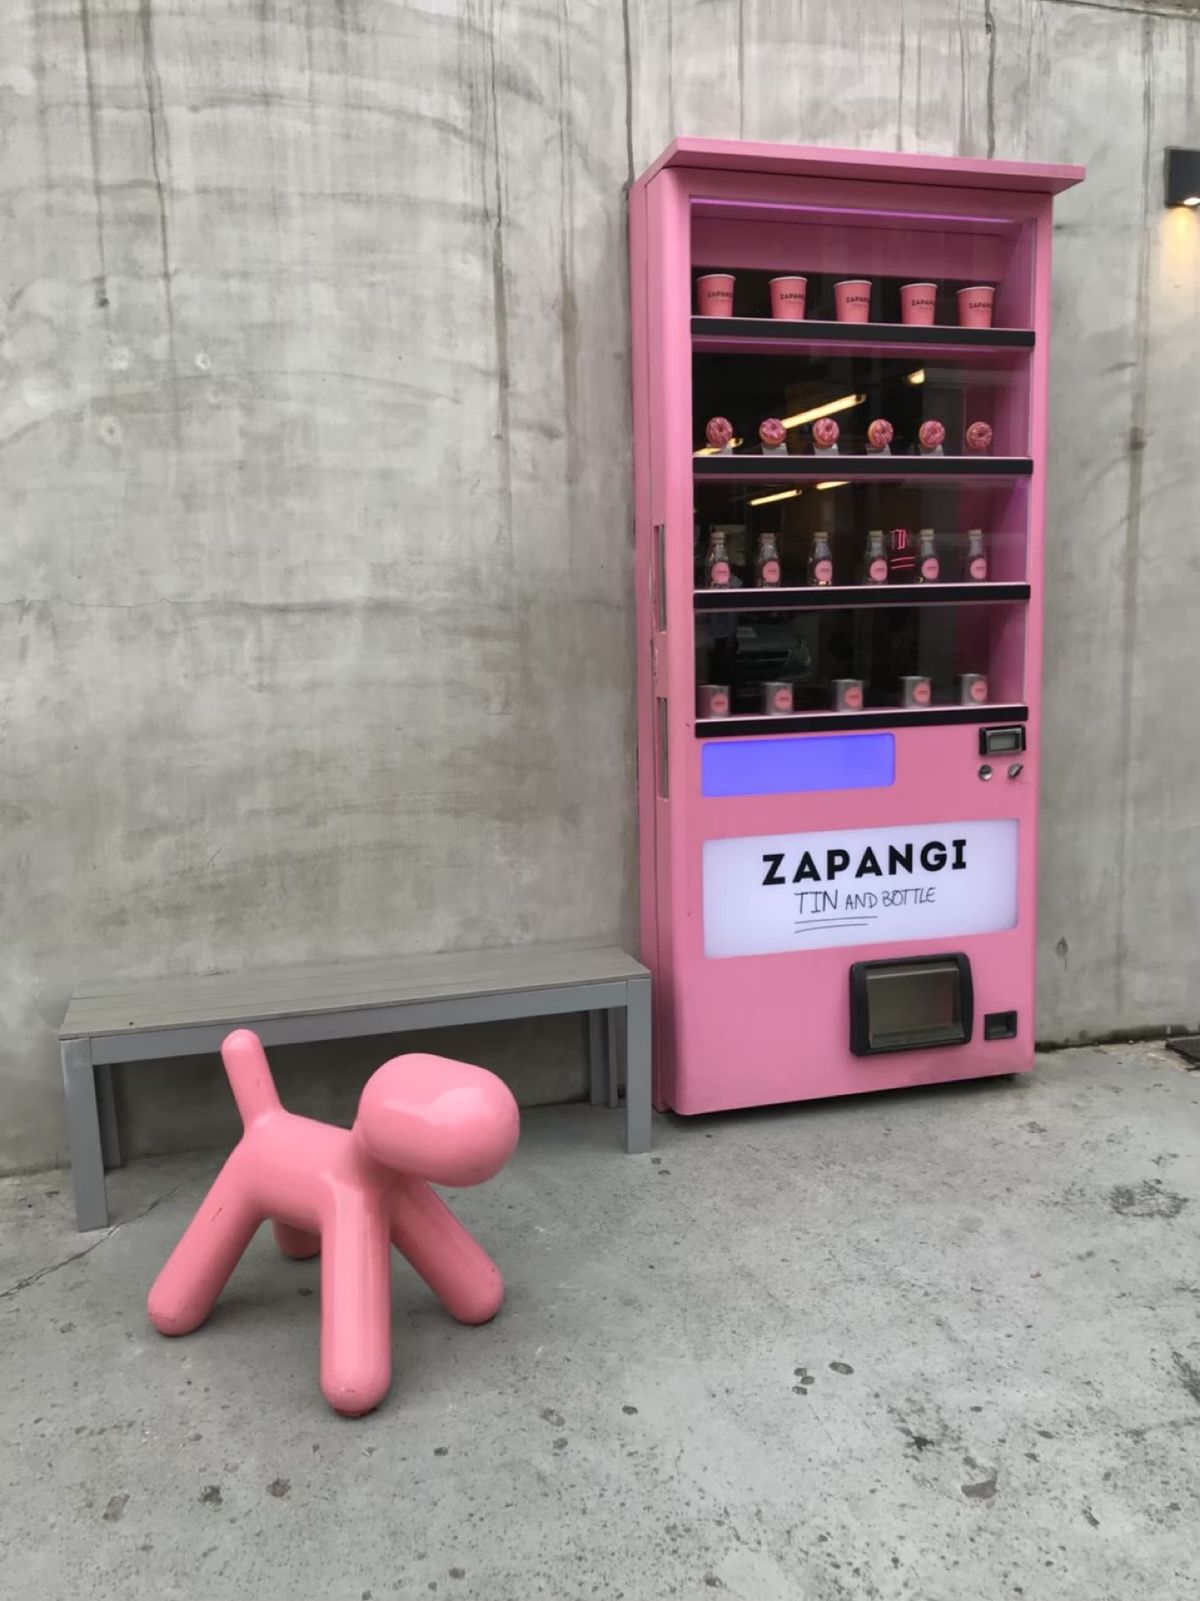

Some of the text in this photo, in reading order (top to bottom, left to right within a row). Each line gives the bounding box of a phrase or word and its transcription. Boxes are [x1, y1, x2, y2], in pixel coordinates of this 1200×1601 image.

[762, 839, 967, 886] ZAPANGI
[794, 887, 936, 914] TIN AND BOTTLE
